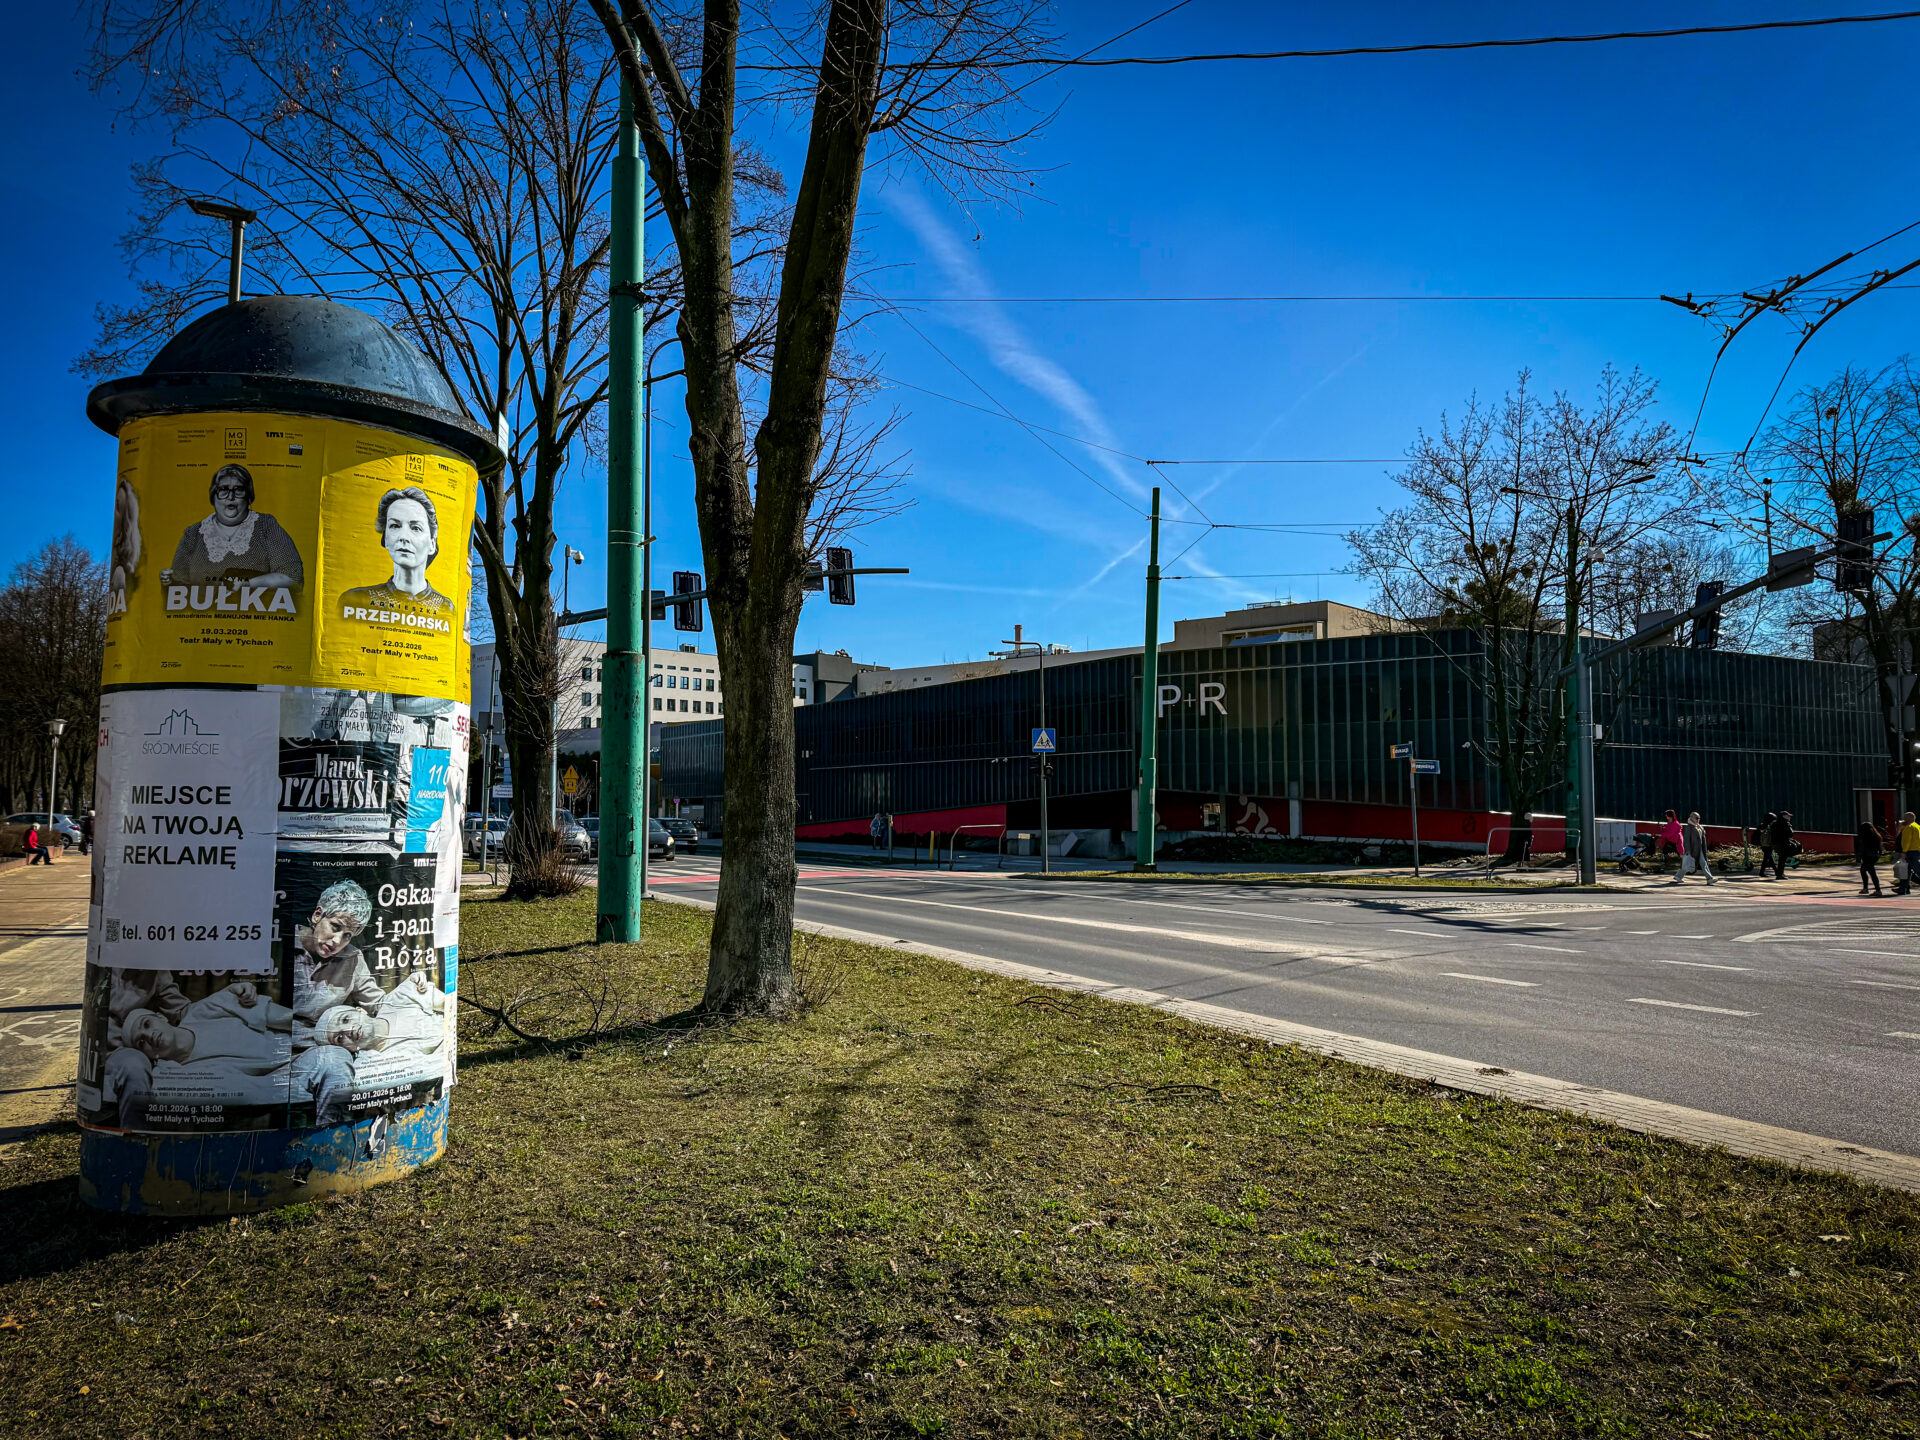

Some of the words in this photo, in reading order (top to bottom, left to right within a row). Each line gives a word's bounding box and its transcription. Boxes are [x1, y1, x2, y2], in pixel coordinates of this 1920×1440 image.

[166, 585, 297, 613] BUŁKA
[370, 600, 438, 615] AGNIESZKA
[343, 606, 450, 633] PRZEPIÓRSKA
[200, 628, 248, 636] 19.03.2026
[202, 637, 223, 646] Mały
[235, 638, 274, 646] Tychach
[382, 640, 422, 650] 22.03.2026
[361, 646, 382, 654] Teatr
[385, 648, 403, 658] Mały
[413, 652, 439, 662] Tychach
[1157, 682, 1228, 718] P+R
[320, 720, 343, 730] TEATR
[346, 721, 365, 731] MAŁY
[142, 740, 220, 755] ŚRÓDMIEŚCIE
[314, 753, 365, 779] Marek
[131, 785, 231, 805] MIEJSCE
[123, 815, 146, 835] NA
[152, 815, 244, 840] TWOJĄ
[123, 845, 237, 870] REKLAMĘ
[377, 883, 435, 907] Oskar
[122, 925, 142, 940] tel.
[147, 925, 176, 941] 601
[184, 925, 219, 941] 624
[225, 925, 262, 941] 255
[375, 916, 385, 939] i
[374, 945, 437, 970] Róża
[351, 1088, 389, 1102] 20.01.2026
[390, 1093, 413, 1105] Tychach
[148, 1104, 190, 1113] 20.01.2026
[201, 1104, 223, 1113] 18:00
[145, 1114, 163, 1122] Teatr
[164, 1114, 182, 1124] Mały
[191, 1115, 225, 1124] Tychach
